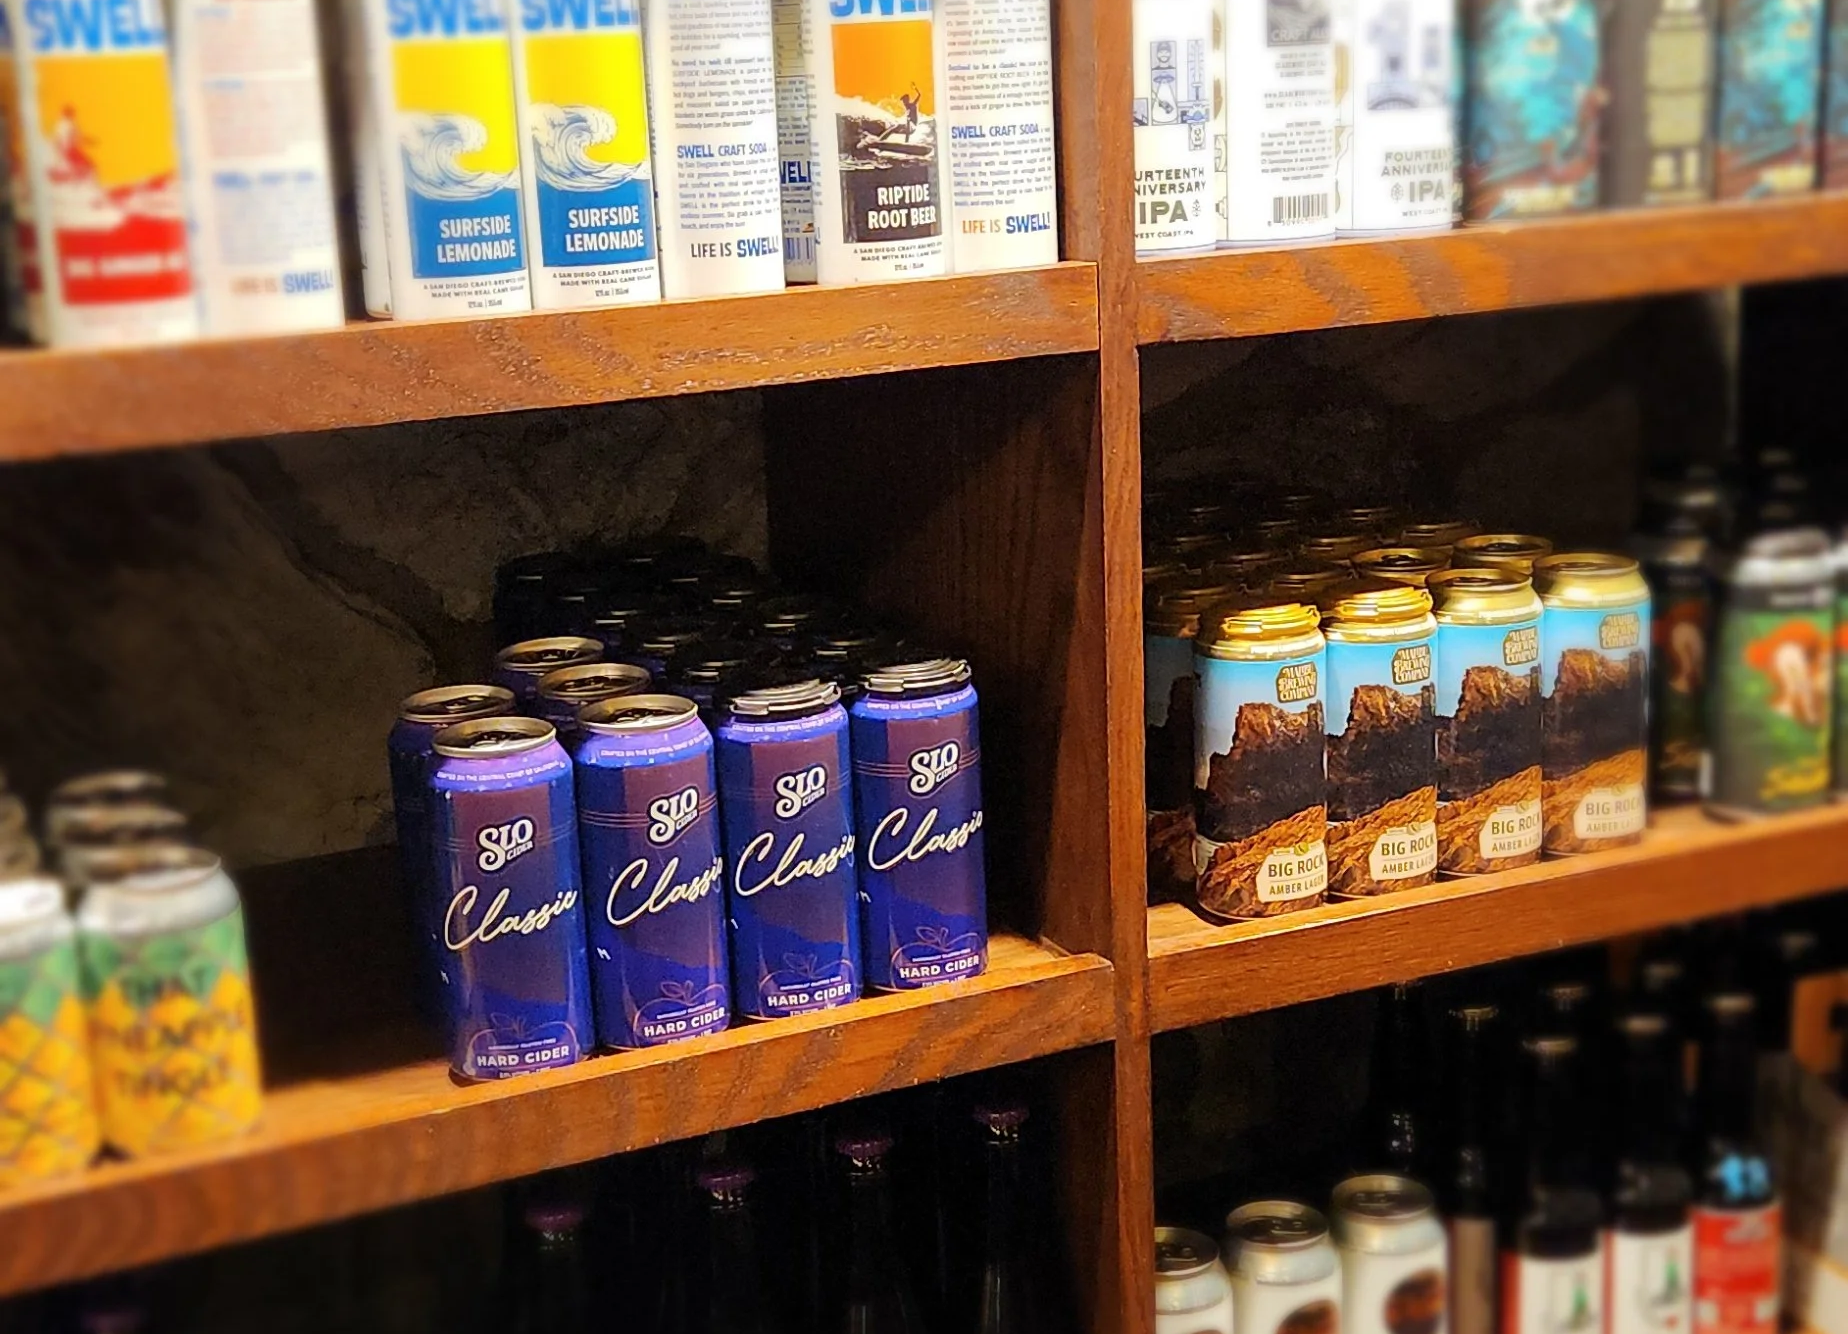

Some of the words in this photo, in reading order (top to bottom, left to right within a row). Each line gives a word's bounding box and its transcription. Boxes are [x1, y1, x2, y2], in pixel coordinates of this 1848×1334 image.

[951, 125, 986, 140] SWELL
[989, 125, 1017, 137] CRAFT
[677, 144, 714, 159] SWELL
[718, 144, 746, 157] CRAFT
[1135, 167, 1204, 182] URTEENTH
[877, 183, 930, 206] RIPTIDE
[1135, 180, 1206, 196] NIVERSARY
[1409, 179, 1445, 203] IPA
[568, 204, 640, 229] SURFSIDE
[868, 208, 908, 230] ROOT
[910, 205, 937, 227] BEER
[962, 219, 986, 234] LIFE
[989, 218, 1001, 234] IS
[1005, 211, 1051, 235] SWELL!
[1139, 199, 1188, 225] IPA
[439, 214, 512, 239] SURFSIDE
[1157, 230, 1181, 238] COAST
[436, 238, 517, 264] LEMONADE
[565, 228, 645, 253] LEMONADE
[691, 242, 717, 258] LIFE
[720, 242, 732, 258] IS
[909, 742, 959, 794] SLO
[775, 766, 826, 819] SLO
[649, 788, 699, 844] SLO
[1586, 801, 1611, 816] BIG
[1491, 819, 1515, 835] BIG
[478, 819, 534, 872] SLO
[1381, 841, 1406, 856] BIG
[1410, 832, 1434, 853] ROCK
[1491, 839, 1522, 852] AMBER
[1268, 862, 1293, 878] BIG
[1297, 852, 1324, 875] ROCK
[1382, 861, 1414, 874] AMBER
[1269, 882, 1302, 895] AMBER
[444, 884, 578, 951] Classic
[900, 965, 941, 979] HARD
[945, 954, 980, 973] CIDER
[767, 993, 810, 1007] HARD
[814, 983, 852, 1001] CIDER
[644, 1020, 687, 1038] HARD
[691, 1006, 726, 1028] CIDER
[476, 1054, 520, 1067] HARD
[524, 1045, 570, 1064] CIDER
